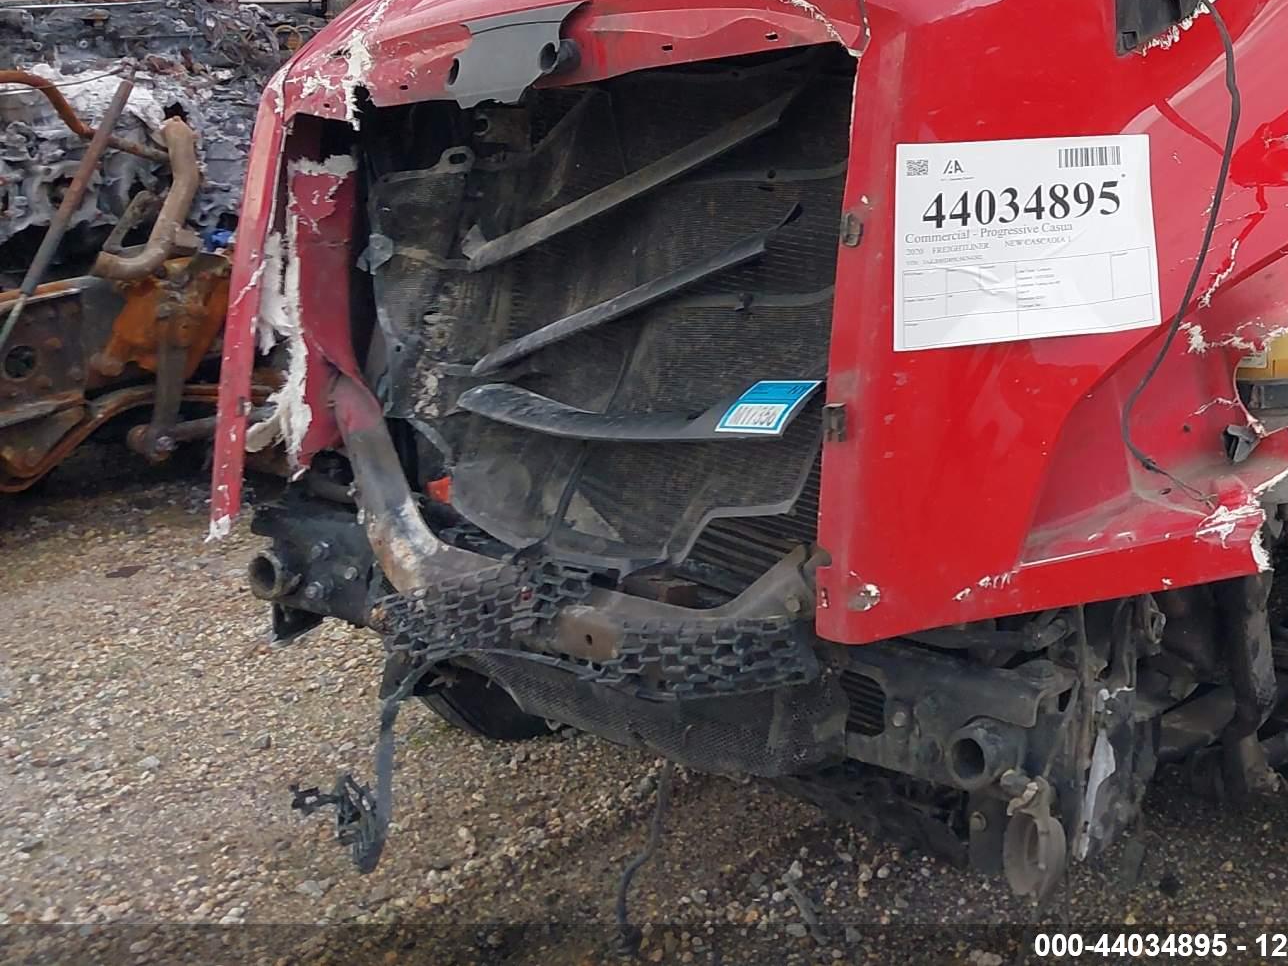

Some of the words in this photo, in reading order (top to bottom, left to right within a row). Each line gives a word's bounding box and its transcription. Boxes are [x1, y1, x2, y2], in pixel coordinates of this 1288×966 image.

[922, 180, 1121, 228] 44034895
[905, 230, 970, 244] Commercial
[980, 225, 1039, 239] Progressive
